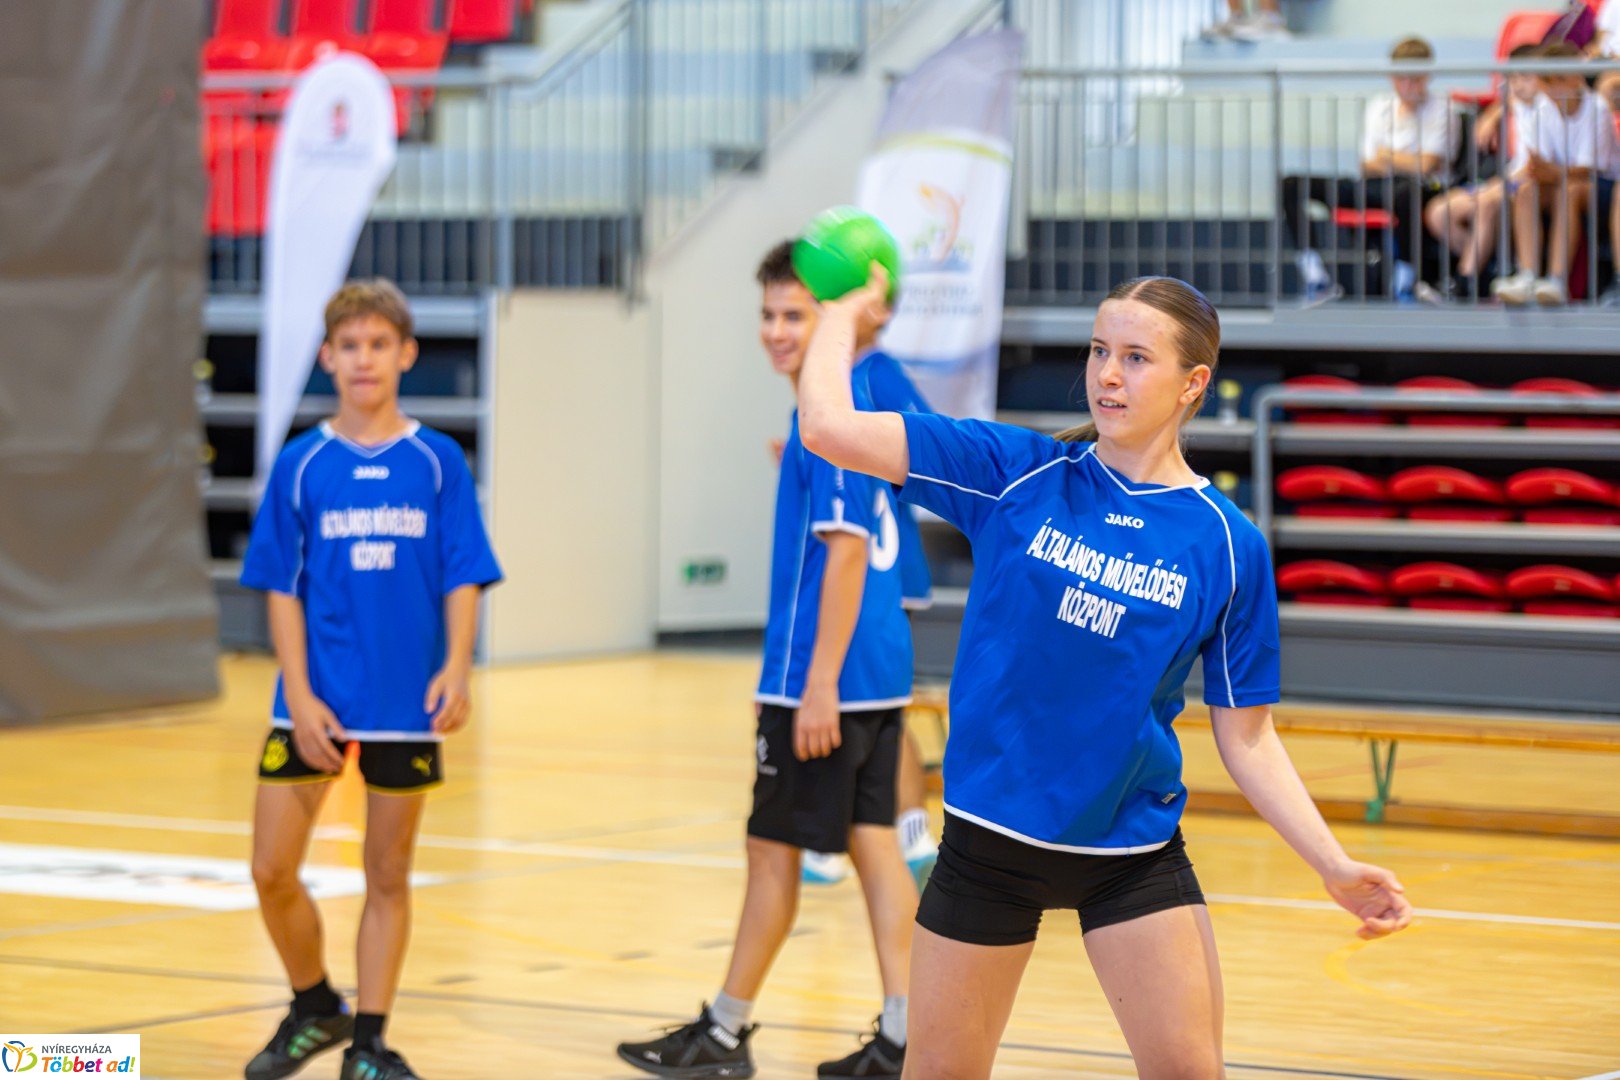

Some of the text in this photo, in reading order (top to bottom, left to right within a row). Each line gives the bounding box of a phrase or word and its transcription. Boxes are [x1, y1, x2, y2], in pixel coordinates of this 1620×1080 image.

[1104, 513, 1144, 529] JAKO
[1026, 517, 1188, 610] ÁLTALÁNOS MŰVELŐDÉSI
[1056, 581, 1127, 639] KÖZPONT
